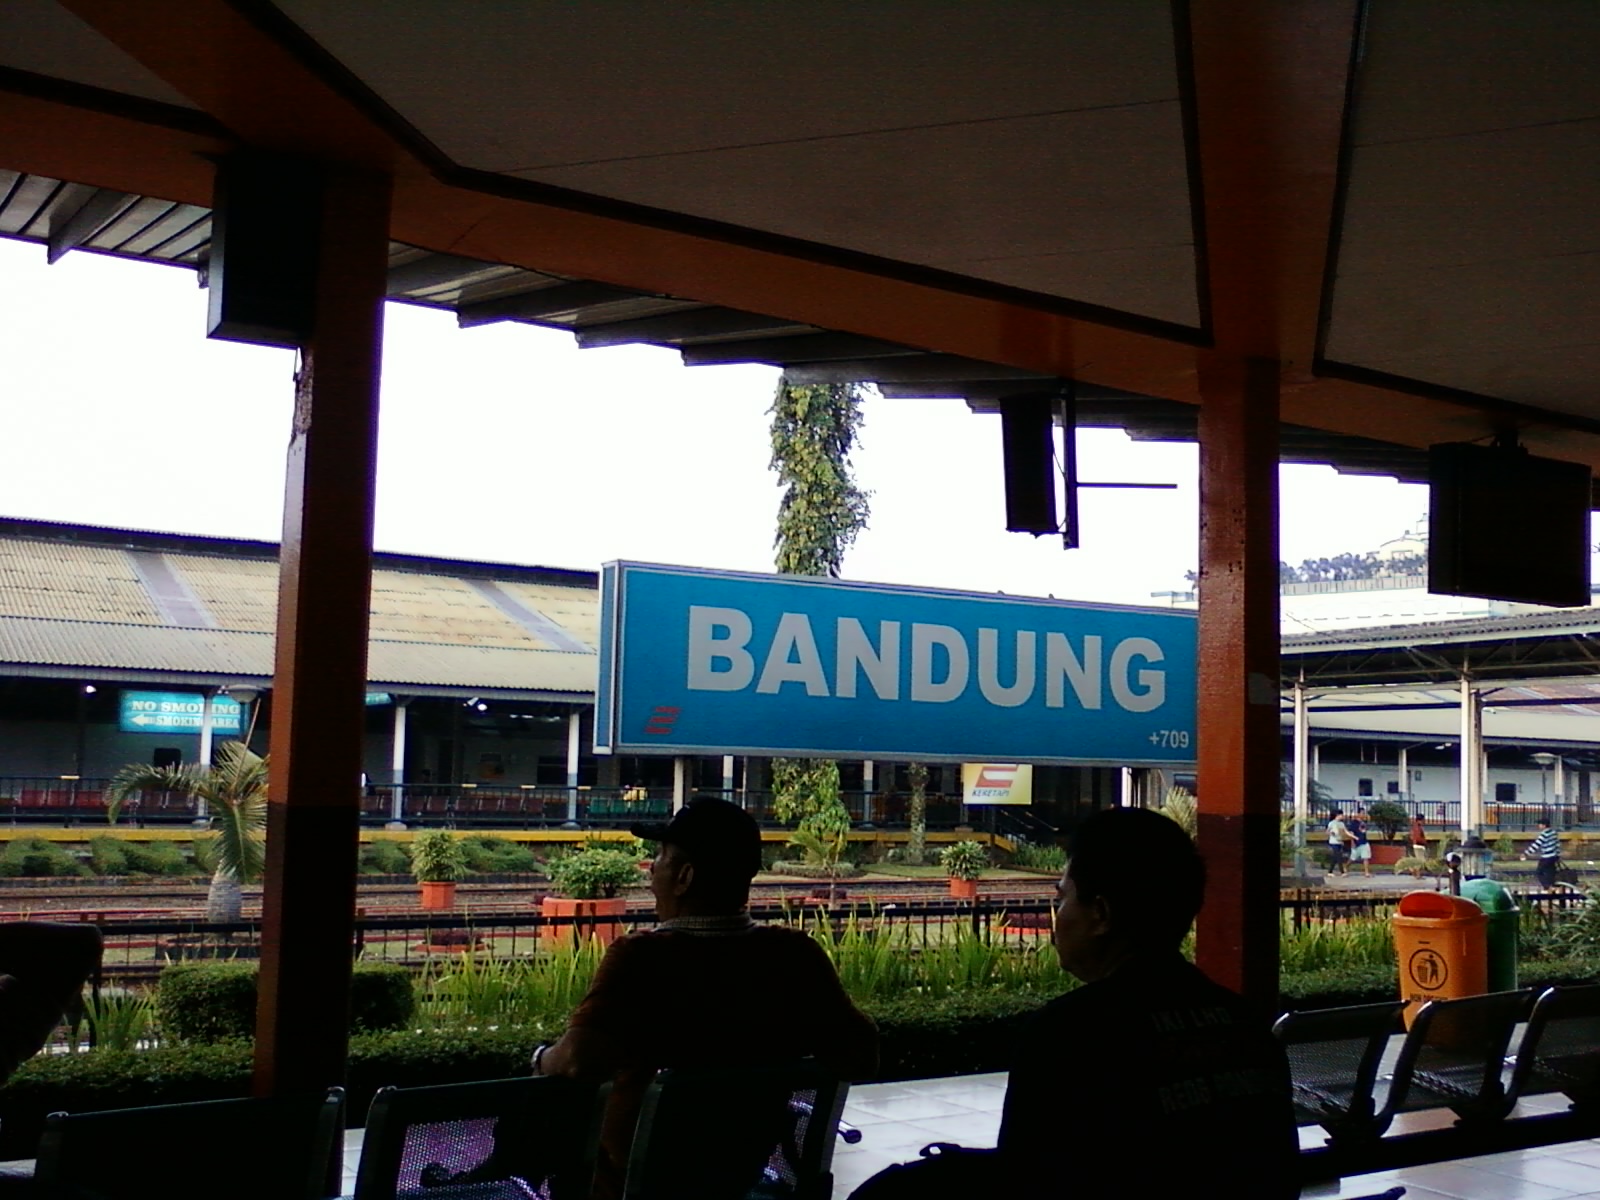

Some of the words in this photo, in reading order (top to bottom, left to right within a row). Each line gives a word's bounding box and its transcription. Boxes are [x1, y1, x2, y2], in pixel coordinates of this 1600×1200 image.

[687, 604, 1166, 713] BANDUNG
[132, 700, 157, 711] NO
[1149, 729, 1190, 749] +709
